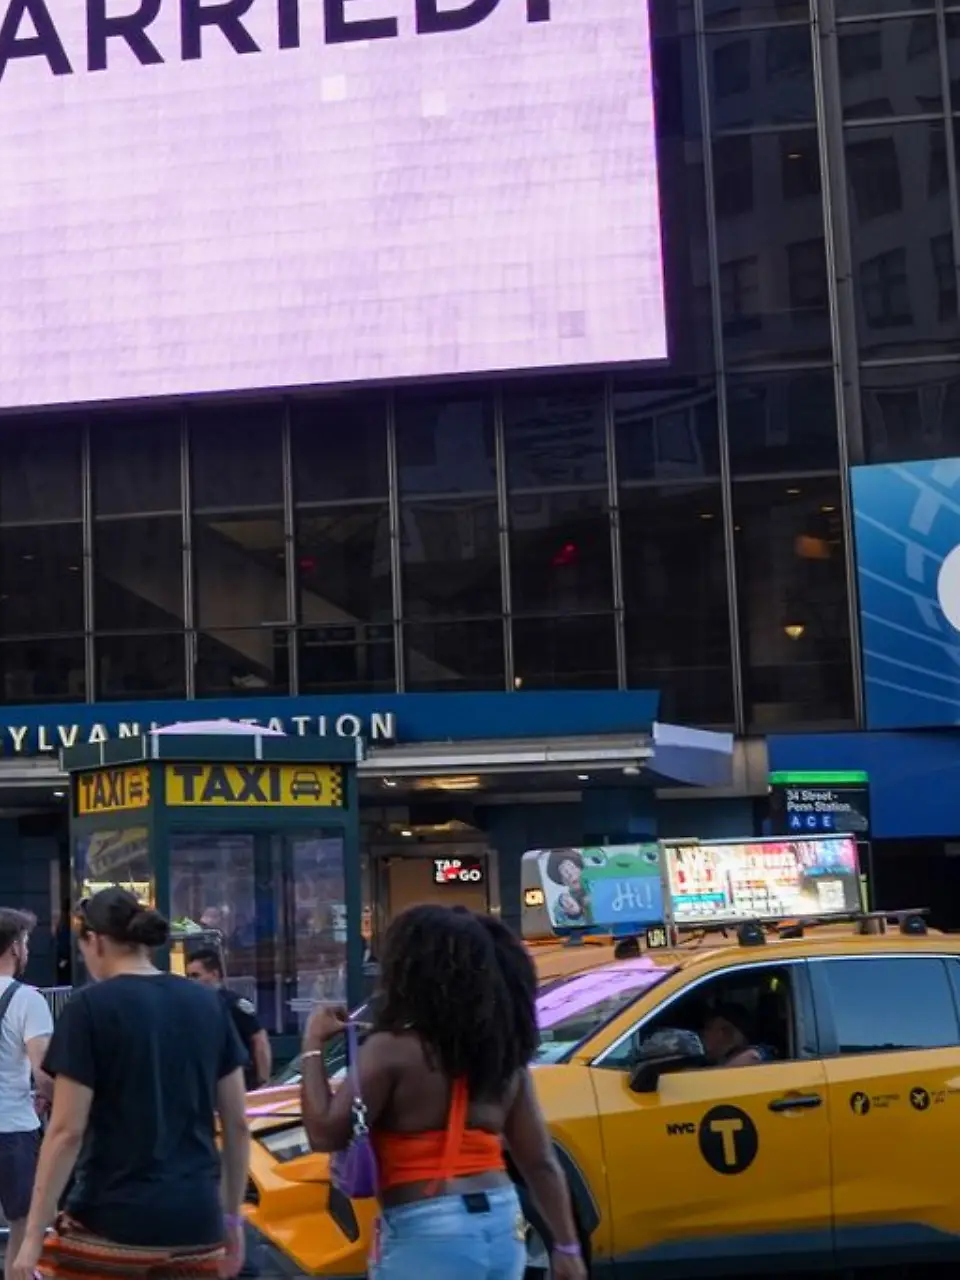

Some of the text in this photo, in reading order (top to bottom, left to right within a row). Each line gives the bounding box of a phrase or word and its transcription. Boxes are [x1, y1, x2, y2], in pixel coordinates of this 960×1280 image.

[81, 771, 126, 810] TAXI
[173, 766, 281, 802] TAXI
[786, 801, 814, 812] Penn
[612, 881, 653, 912] Hi!
[666, 1118, 744, 1166] NYC T
